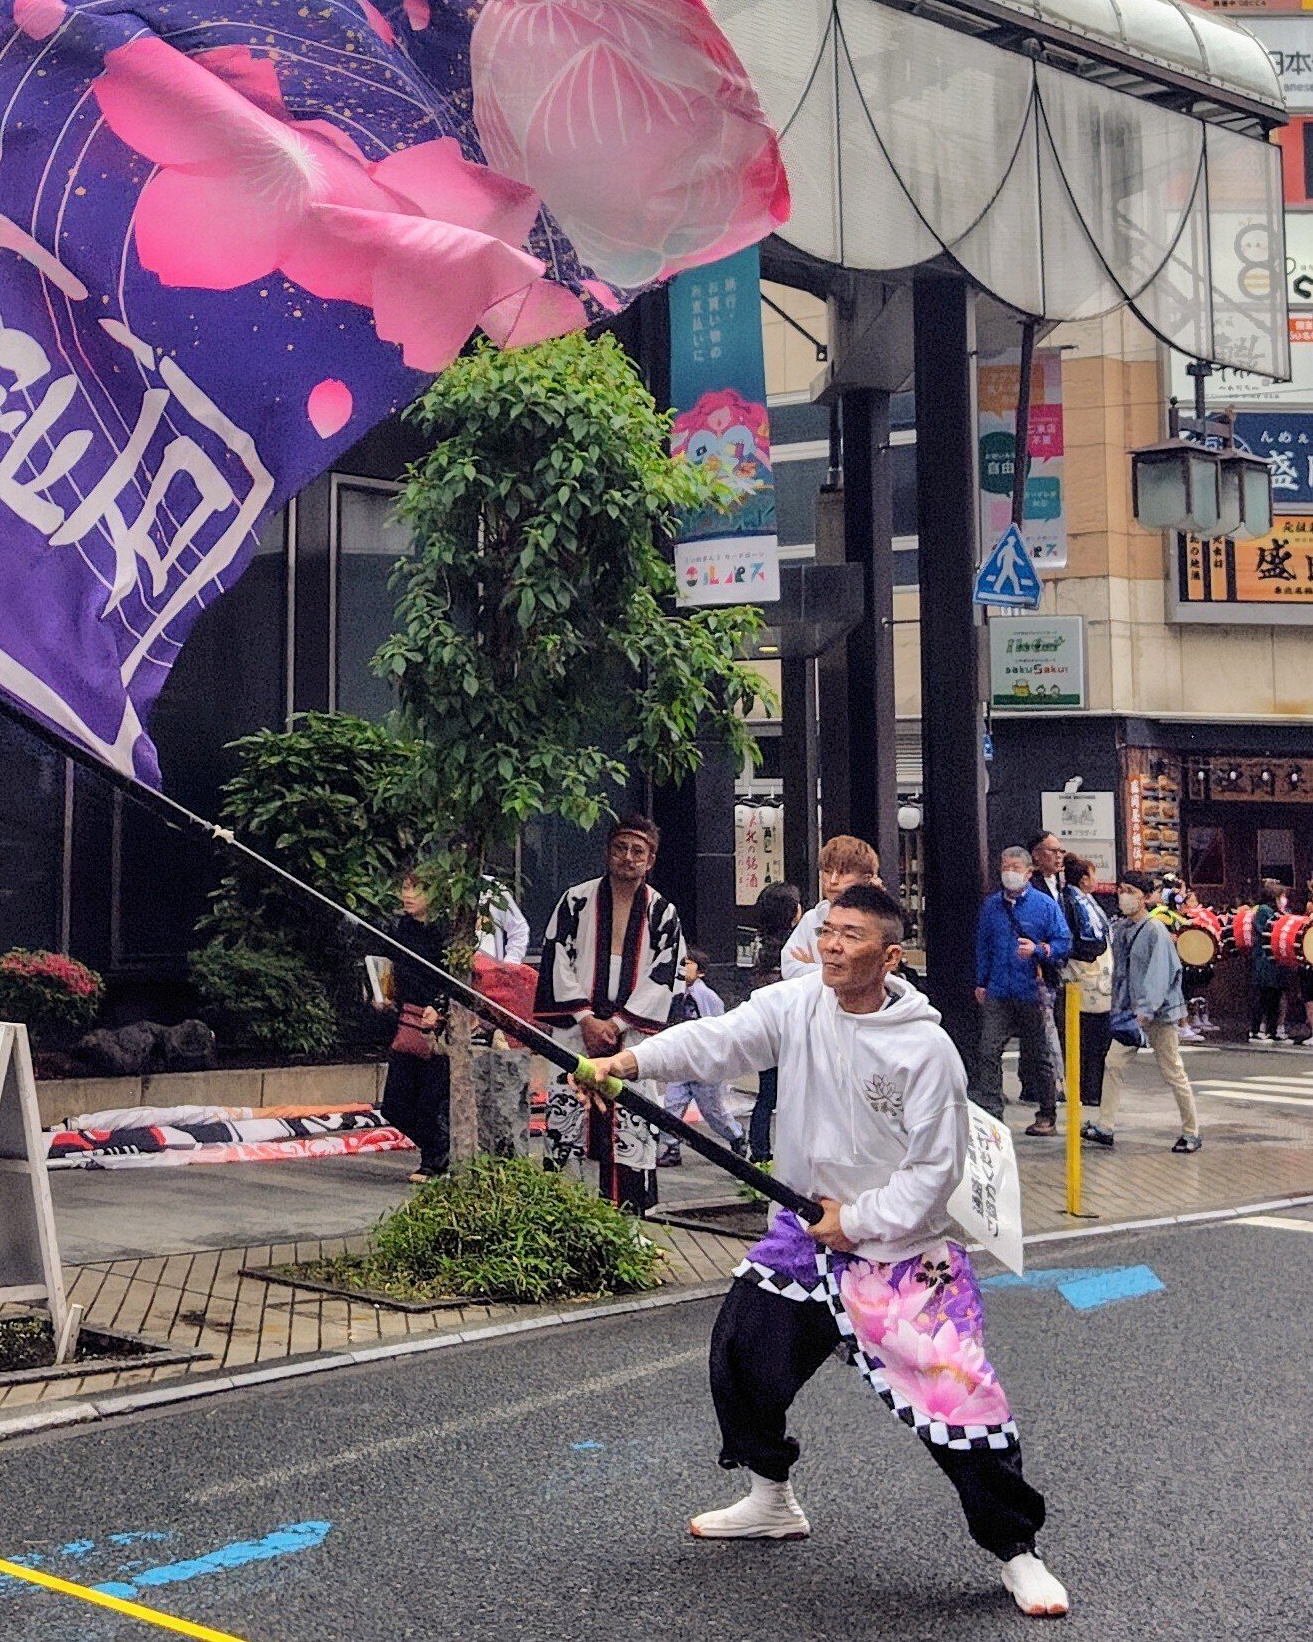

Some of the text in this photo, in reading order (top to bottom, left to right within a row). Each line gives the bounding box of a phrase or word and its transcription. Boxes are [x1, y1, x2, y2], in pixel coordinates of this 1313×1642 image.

[1267, 50, 1313, 76] 日本
[1267, 449, 1313, 491] 盛
[1255, 538, 1313, 581] 盛
